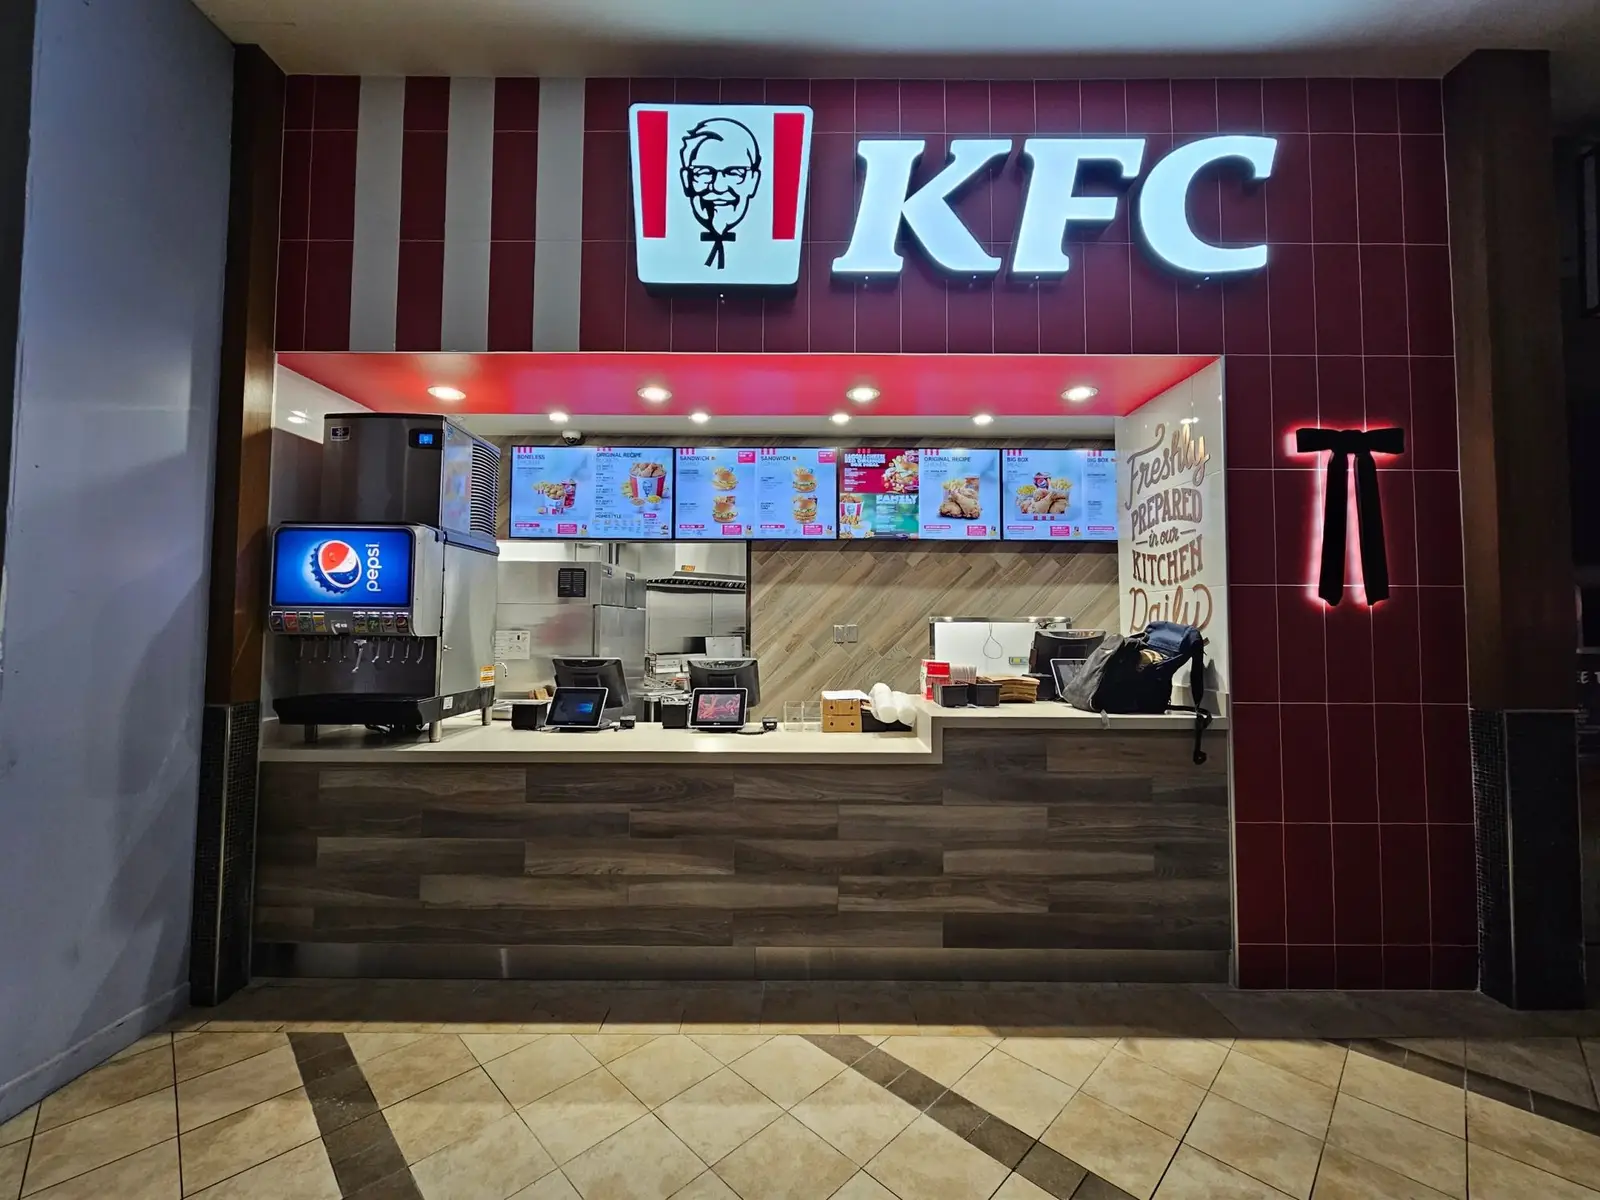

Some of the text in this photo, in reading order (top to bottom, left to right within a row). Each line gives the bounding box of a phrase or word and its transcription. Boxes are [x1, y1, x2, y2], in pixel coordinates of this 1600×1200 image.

[832, 134, 1278, 275] KFC
[1124, 423, 1211, 511] Freshly
[876, 494, 917, 504] FAMILY
[1131, 487, 1203, 542] PREPARED
[1131, 533, 1204, 586] KITCHEN
[1148, 526, 1179, 548] in our
[365, 543, 382, 592] pepsi
